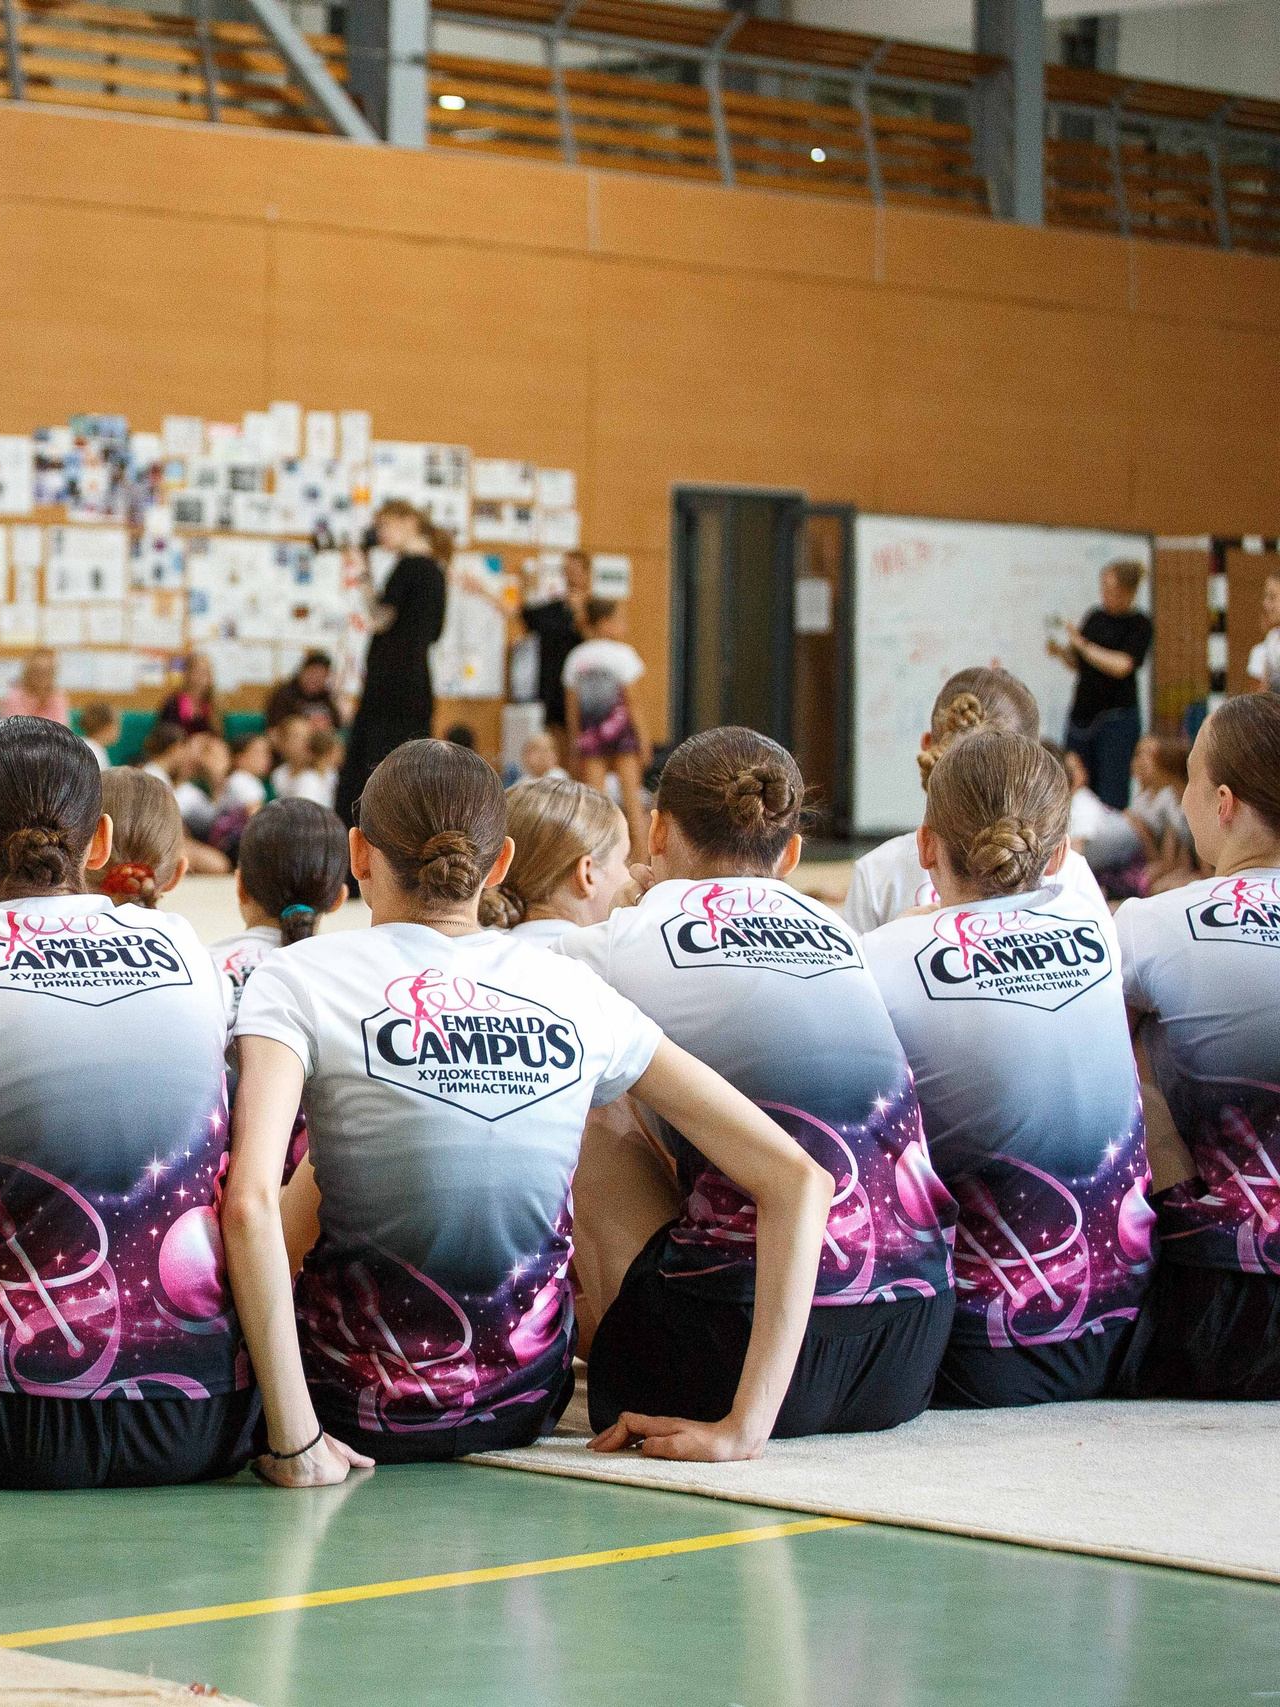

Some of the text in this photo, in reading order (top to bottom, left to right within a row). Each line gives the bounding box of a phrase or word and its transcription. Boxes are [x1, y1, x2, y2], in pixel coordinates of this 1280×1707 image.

[730, 917, 820, 930] EMERALD
[36, 935, 143, 950] EMERALD
[677, 920, 854, 957] CAMPUS
[982, 929, 1071, 951] EMERALD
[722, 949, 842, 961] ХУДОЖЕСТВЕННАЯ
[746, 957, 836, 966] ГИМНАСТИКА
[930, 927, 1105, 984] CAMPUS
[10, 970, 160, 981] ХУДОЖЕСТВЕННАЯ
[976, 968, 1091, 990] ХУДОЖЕСТВЕННАЯ
[34, 979, 147, 988] ГИМНАСТИКА
[998, 980, 1083, 996] ГИМНАСТИКА
[441, 1015, 545, 1034] EMERALD
[376, 1019, 576, 1070] CAMPUS
[418, 1069, 549, 1083] ХУДОЖЕСТВЕННАЯ
[439, 1082, 536, 1096] ГИМНАСТИКА
